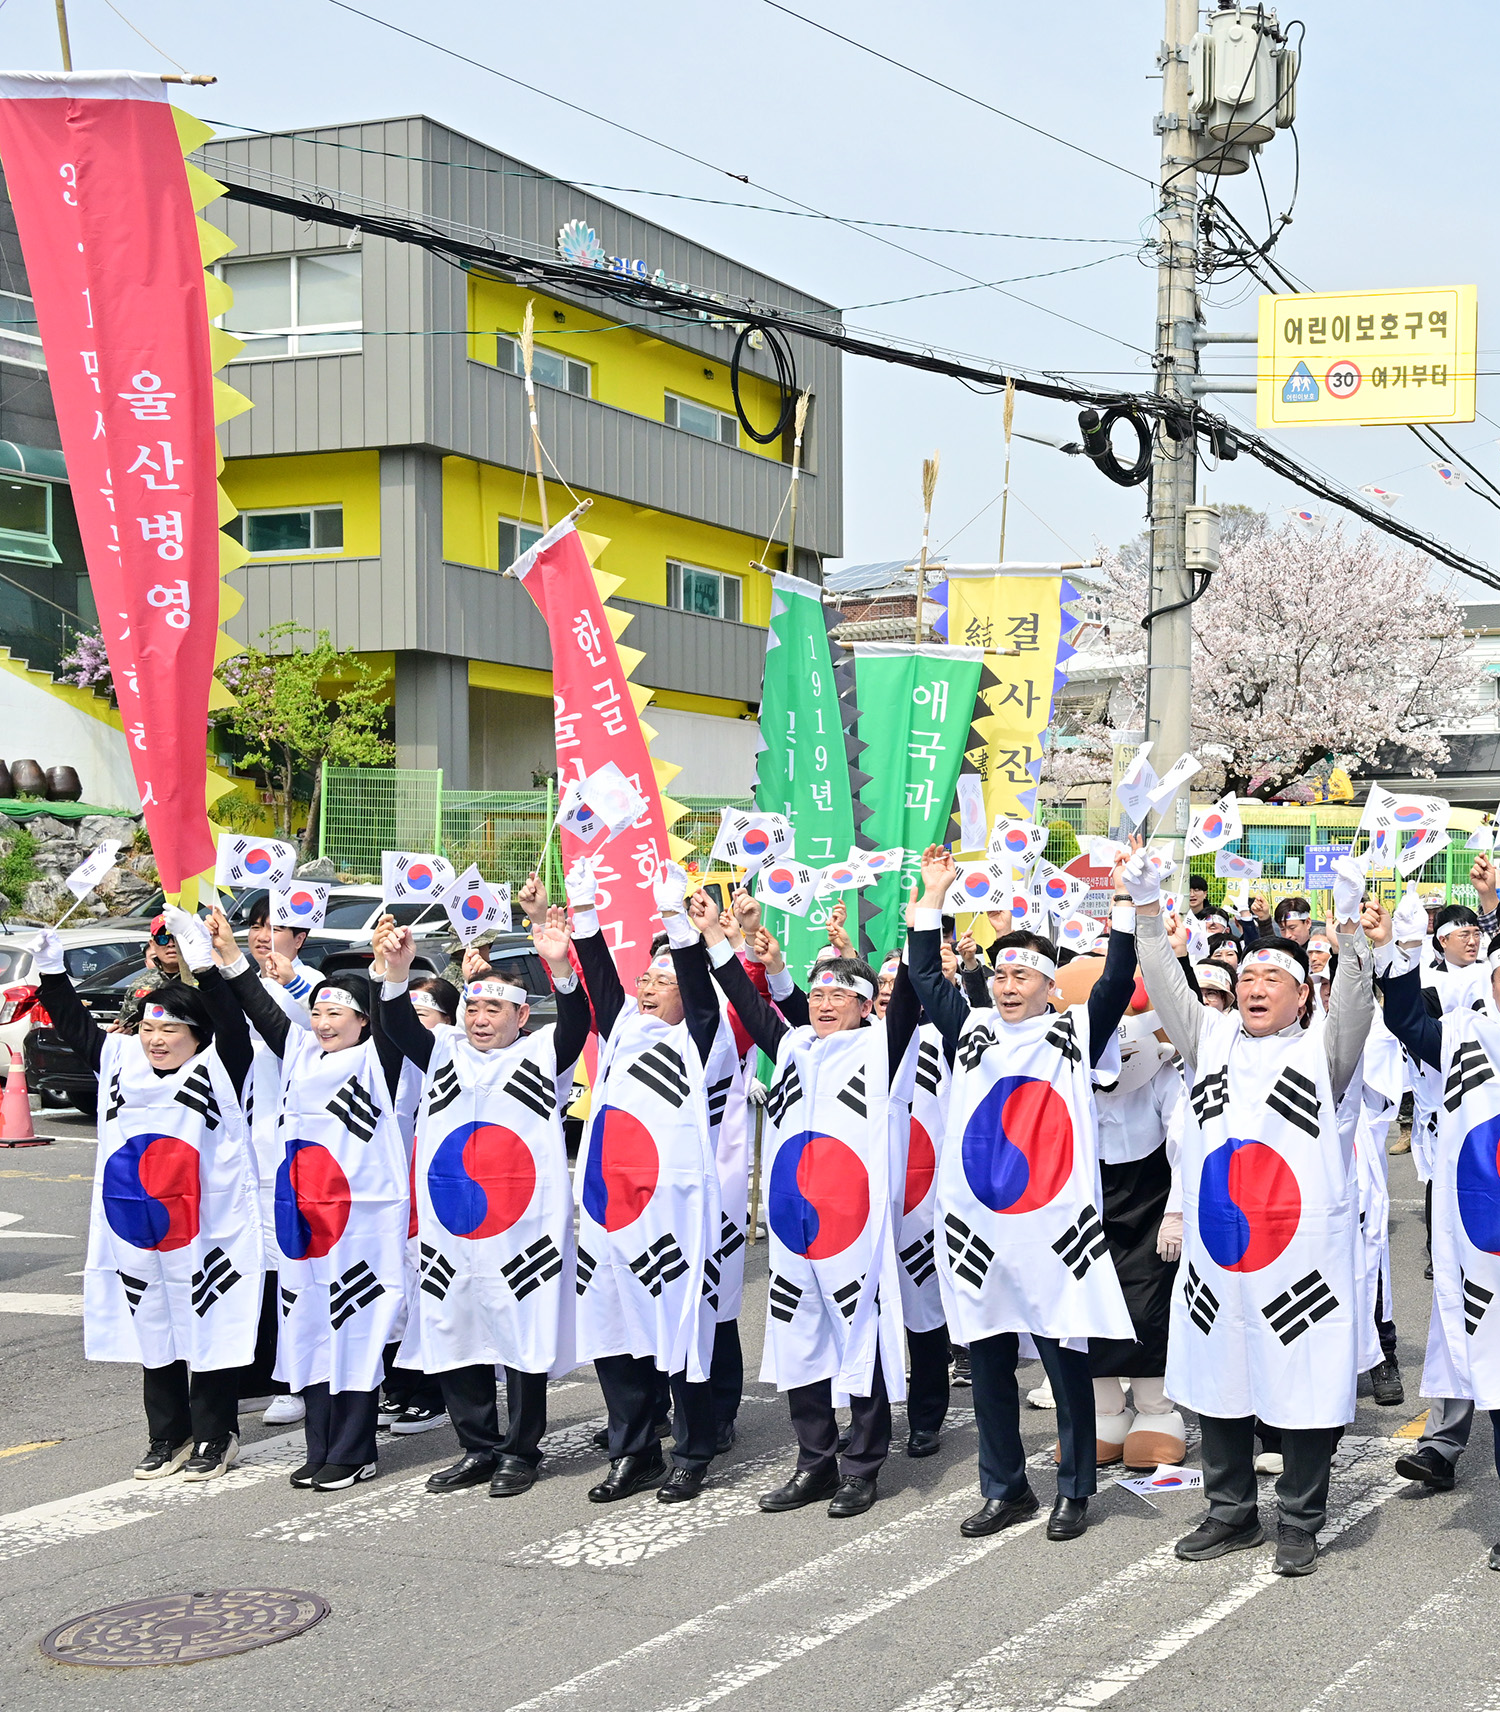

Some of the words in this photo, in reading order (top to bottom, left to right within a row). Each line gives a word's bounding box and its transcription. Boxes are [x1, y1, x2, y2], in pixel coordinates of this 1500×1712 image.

[1284, 310, 1448, 345] 어린이보호구역
[1332, 372, 1354, 388] 30
[1371, 364, 1448, 389] 여기부터
[1286, 393, 1315, 402] 어린이보호
[117, 369, 191, 630] 울산병영
[571, 609, 627, 736] 한글
[807, 634, 834, 812] 1919년
[904, 680, 949, 822] 애국과
[1315, 854, 1327, 871] P
[806, 837, 836, 932] 그의
[1019, 951, 1040, 968] 독립
[1273, 952, 1293, 969] 독립
[333, 989, 354, 1005] 독립
[485, 981, 505, 998] 독립
